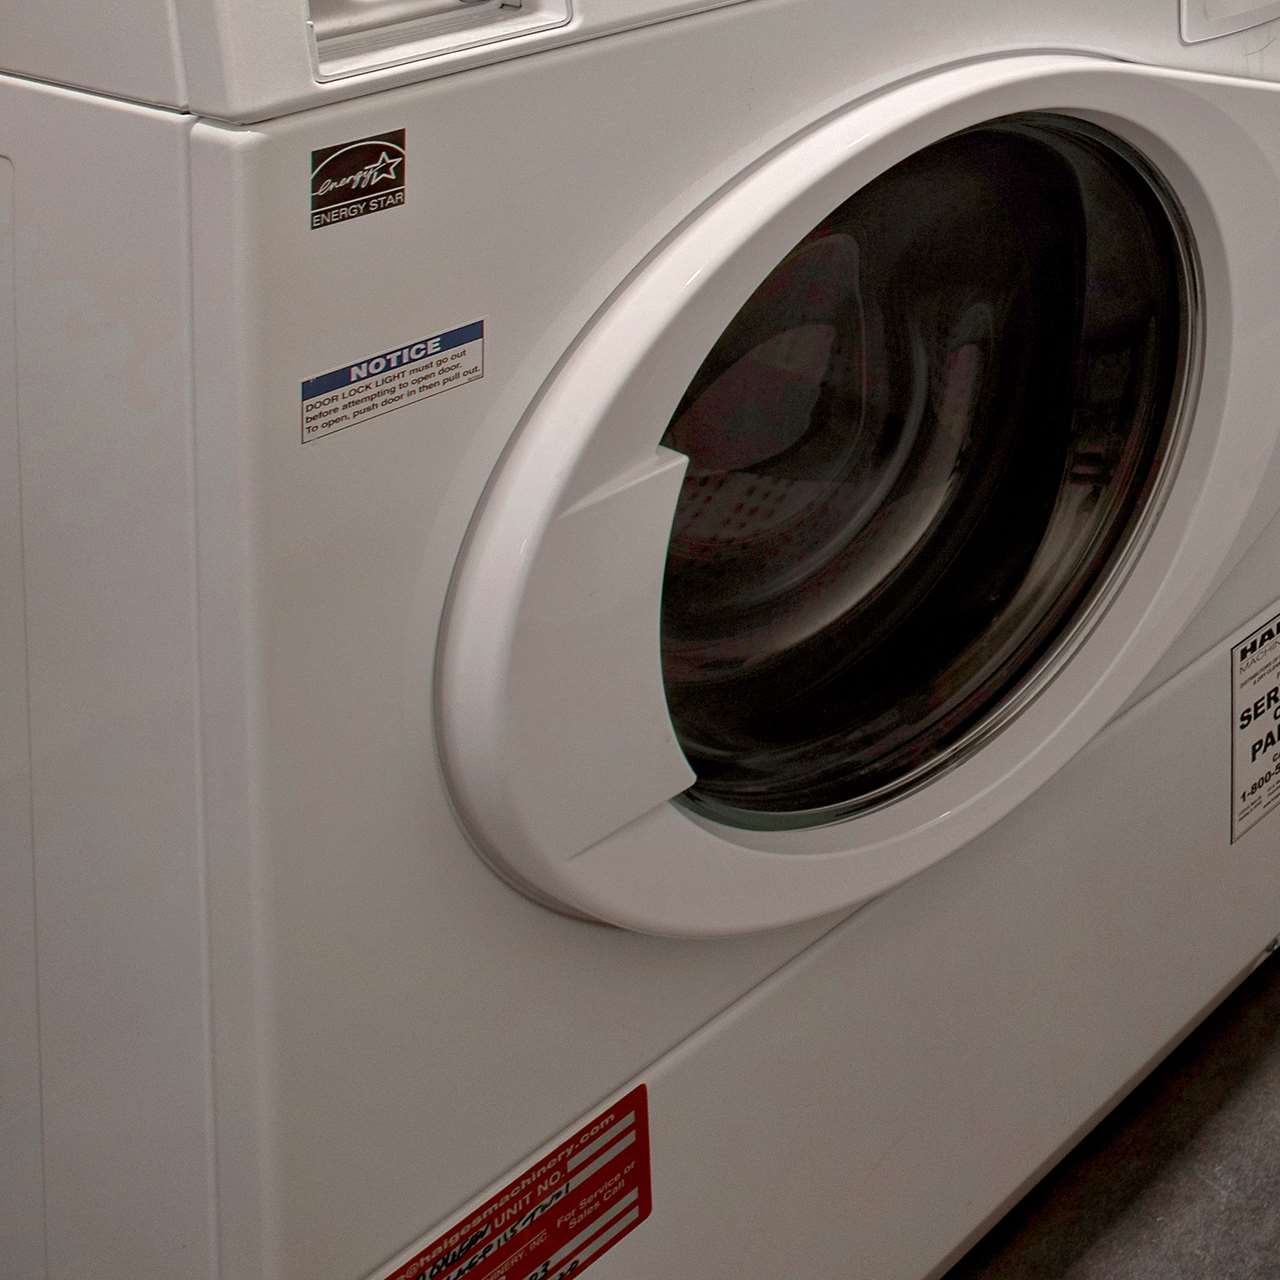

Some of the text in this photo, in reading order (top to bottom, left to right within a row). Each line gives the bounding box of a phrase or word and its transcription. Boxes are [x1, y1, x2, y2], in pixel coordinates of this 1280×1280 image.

[313, 192, 405, 227] ENERGY STAR
[306, 349, 467, 413] DOOR LOCK LIGHT must go out
[350, 337, 442, 383] NOTICE
[305, 425, 319, 434] To
[353, 403, 379, 418] push
[381, 393, 405, 408] door
[407, 386, 417, 398] in
[418, 379, 441, 394] then
[442, 371, 461, 388] pull
[306, 407, 340, 424] before
[342, 386, 397, 411] attempting
[399, 380, 410, 391] to
[411, 370, 437, 390] open
[494, 1171, 567, 1229] UNIT NO.
[557, 1161, 636, 1228] For Service or
[568, 1179, 625, 1230] Sales Call
